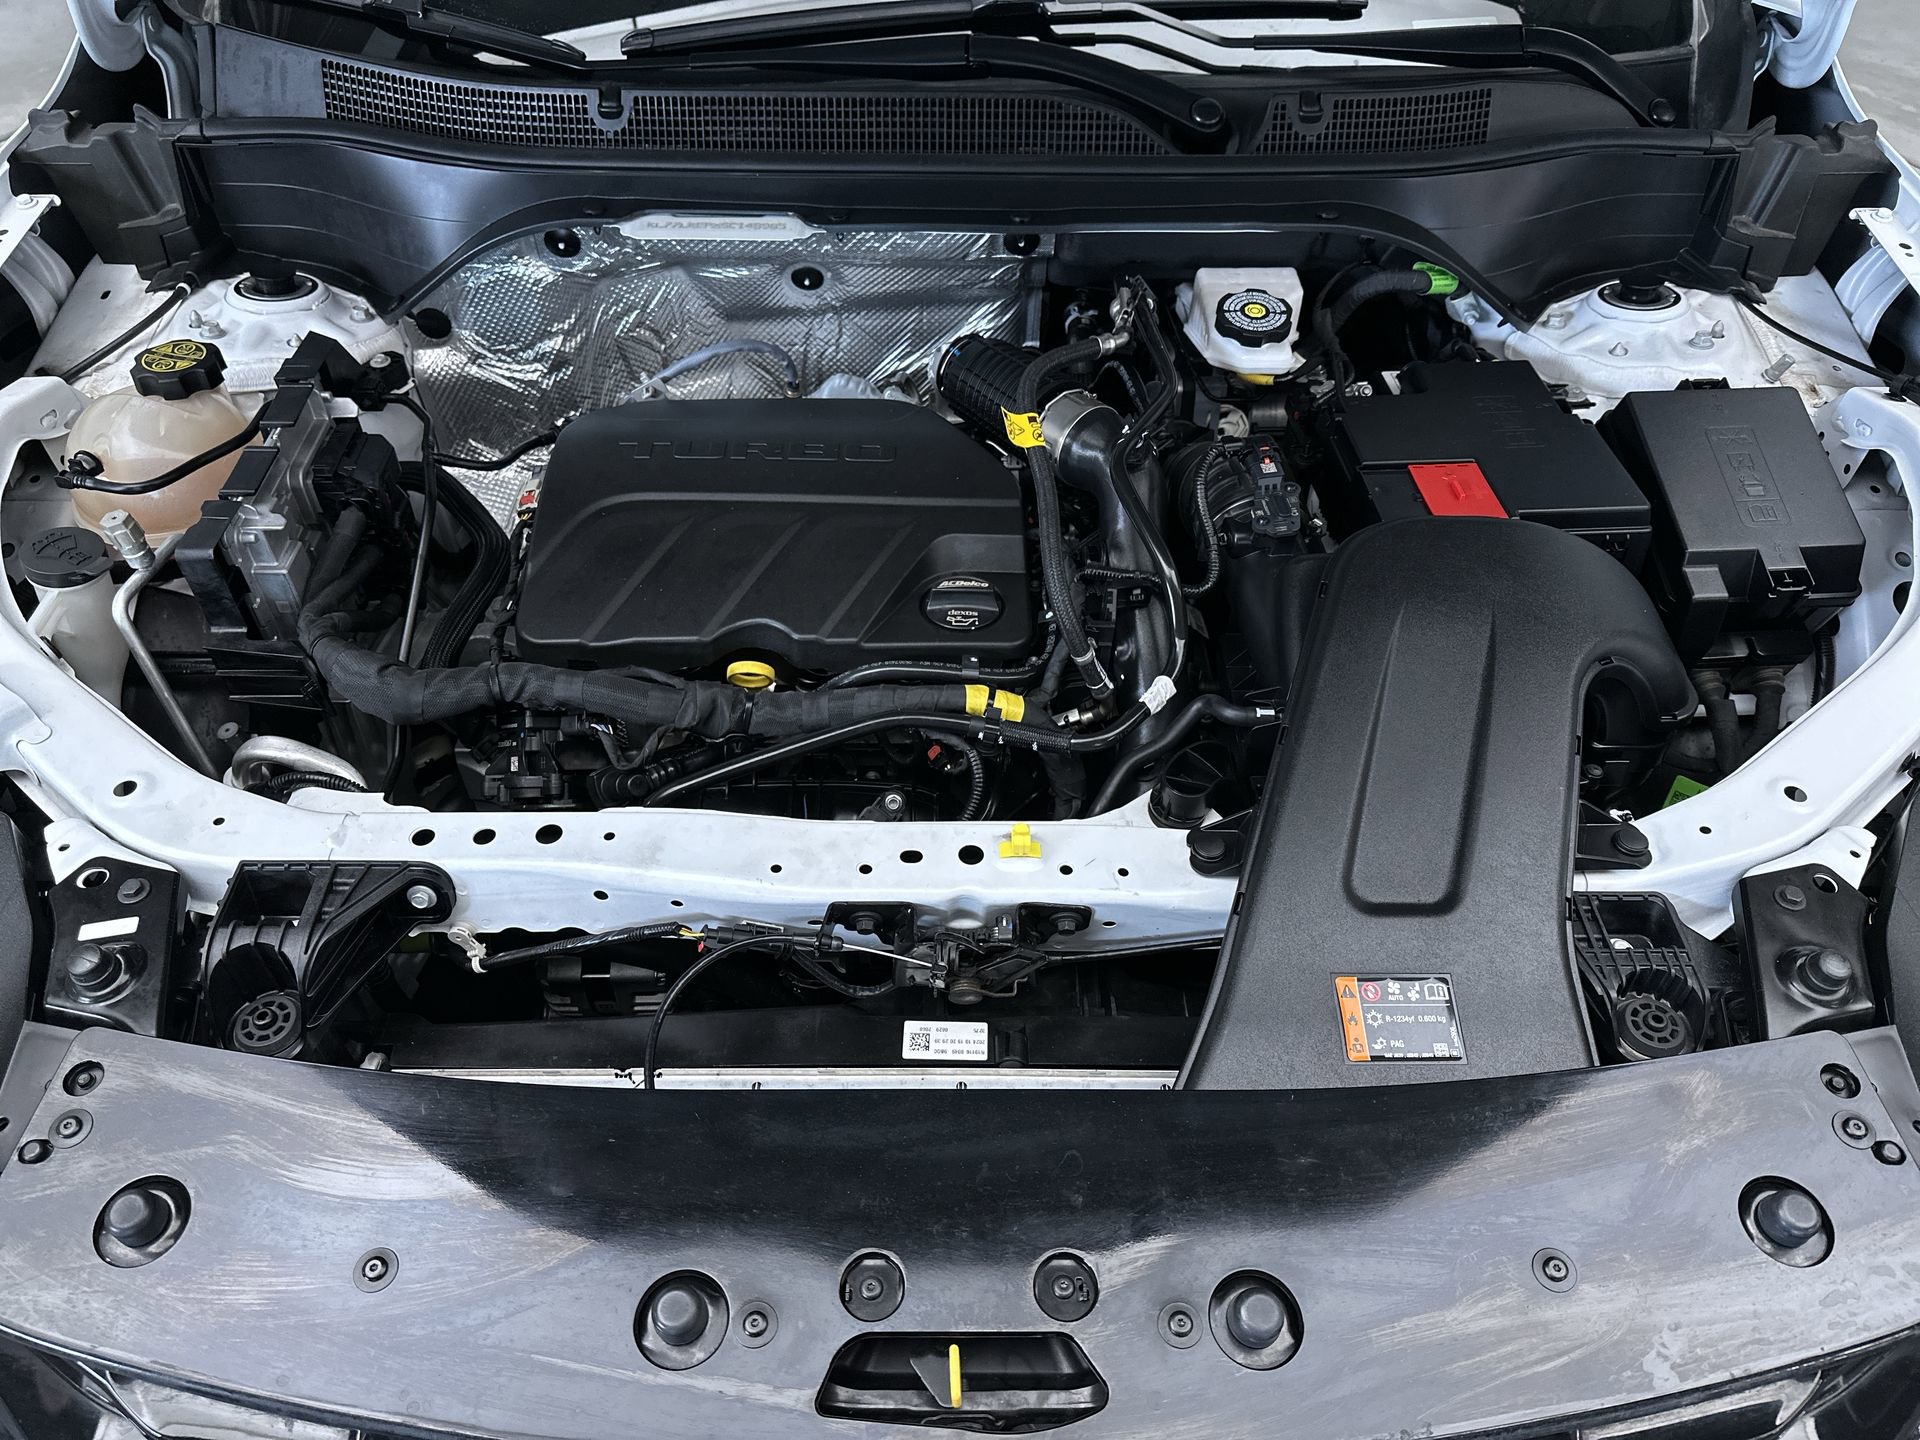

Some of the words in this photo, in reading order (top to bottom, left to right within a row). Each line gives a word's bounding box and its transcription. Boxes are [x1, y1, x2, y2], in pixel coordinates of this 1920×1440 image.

[618, 440, 897, 463] TURBO
[937, 580, 989, 588] ACDelco
[1385, 1015, 1415, 1024] R-1234yf
[1437, 1015, 1446, 1024] kg
[1390, 1040, 1405, 1048] PAG
